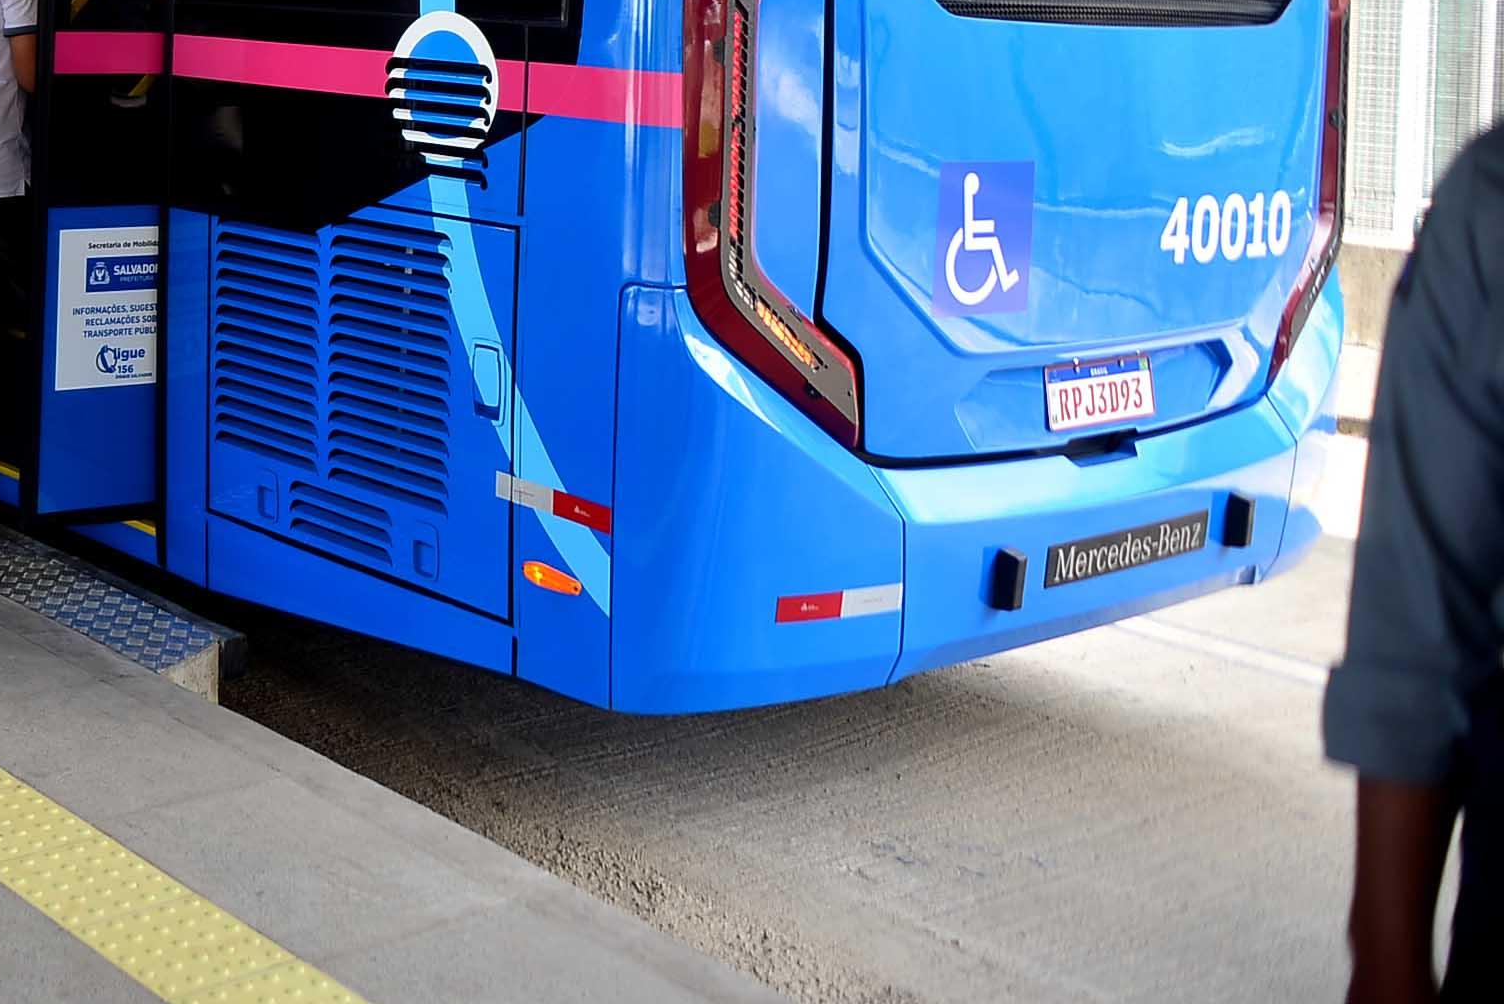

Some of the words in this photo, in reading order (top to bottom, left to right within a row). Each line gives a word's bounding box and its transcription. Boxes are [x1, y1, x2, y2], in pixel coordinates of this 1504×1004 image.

[1159, 189, 1292, 265] 40010
[88, 241, 122, 249] Secretaria
[122, 240, 132, 248] de
[85, 315, 141, 327] RECLAMAÇÕES
[83, 327, 133, 338] TRANSPORTE
[117, 364, 134, 374] 156
[1058, 377, 1143, 422] RPJ3D93
[1053, 521, 1202, 583] Mercedes-Benz
